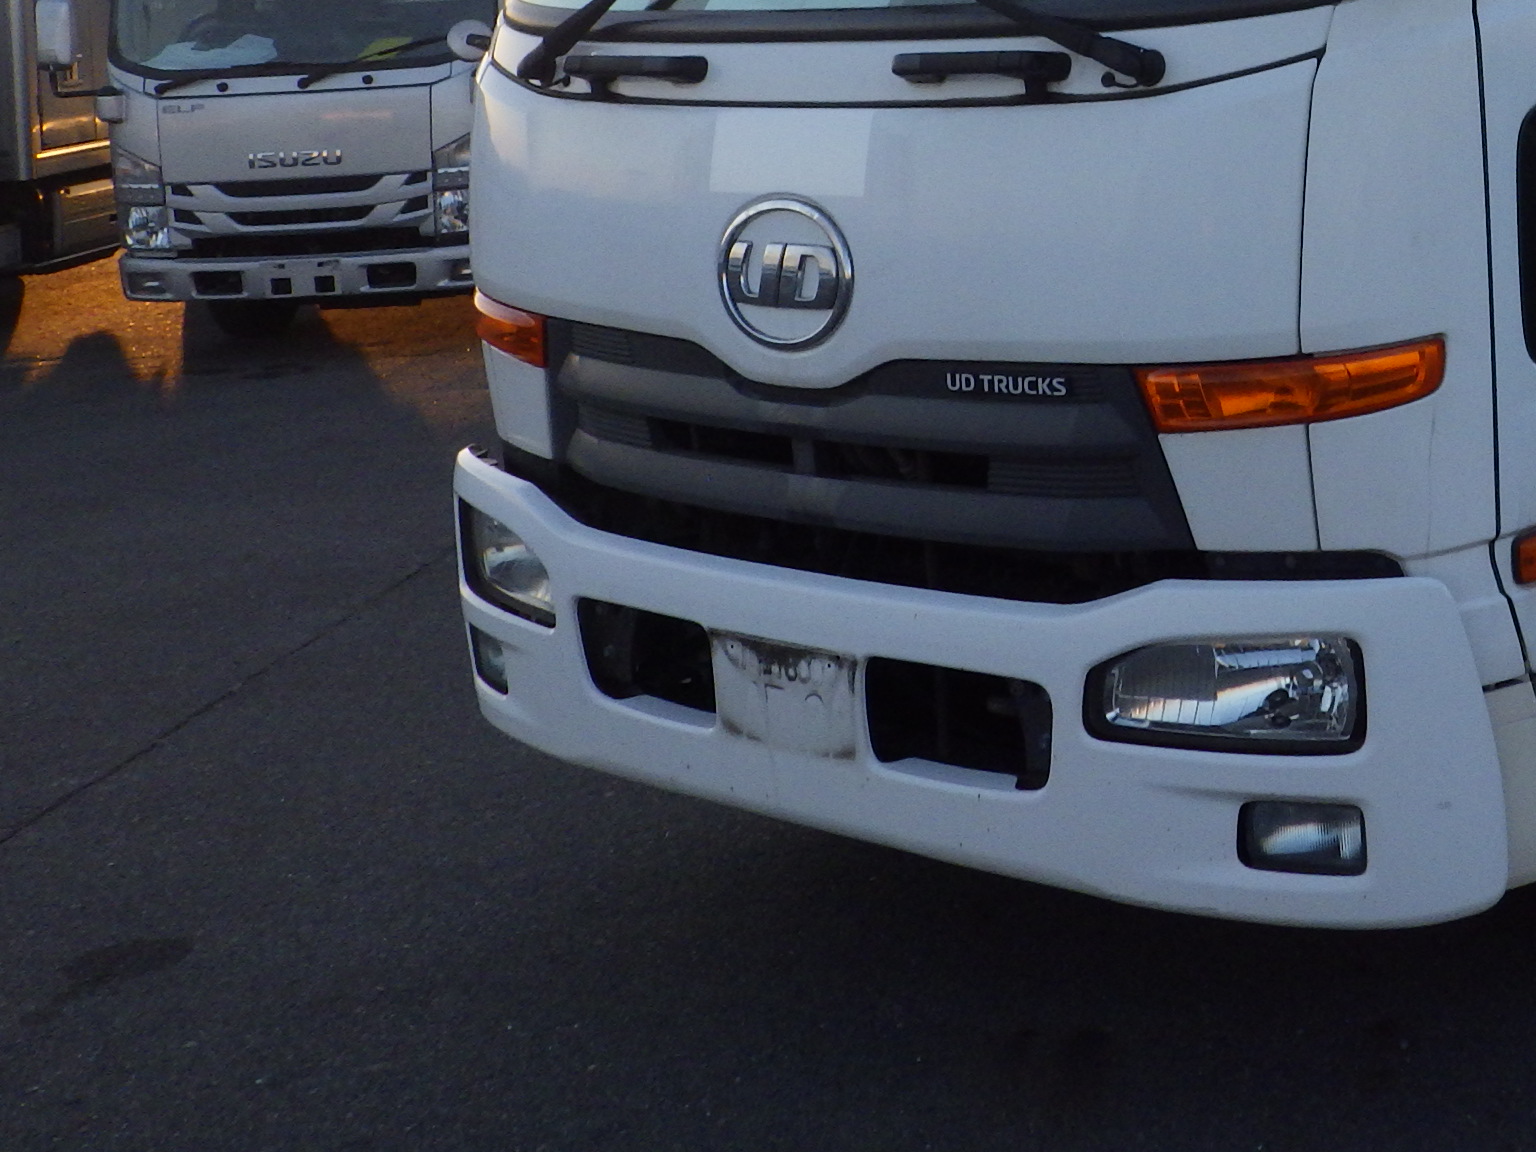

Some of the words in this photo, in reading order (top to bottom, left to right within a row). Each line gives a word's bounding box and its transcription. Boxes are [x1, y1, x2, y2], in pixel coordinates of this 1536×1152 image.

[248, 149, 342, 169] ISUZU
[727, 241, 839, 310] UD
[946, 372, 975, 391] UD
[979, 374, 1067, 396] TRUCKS
